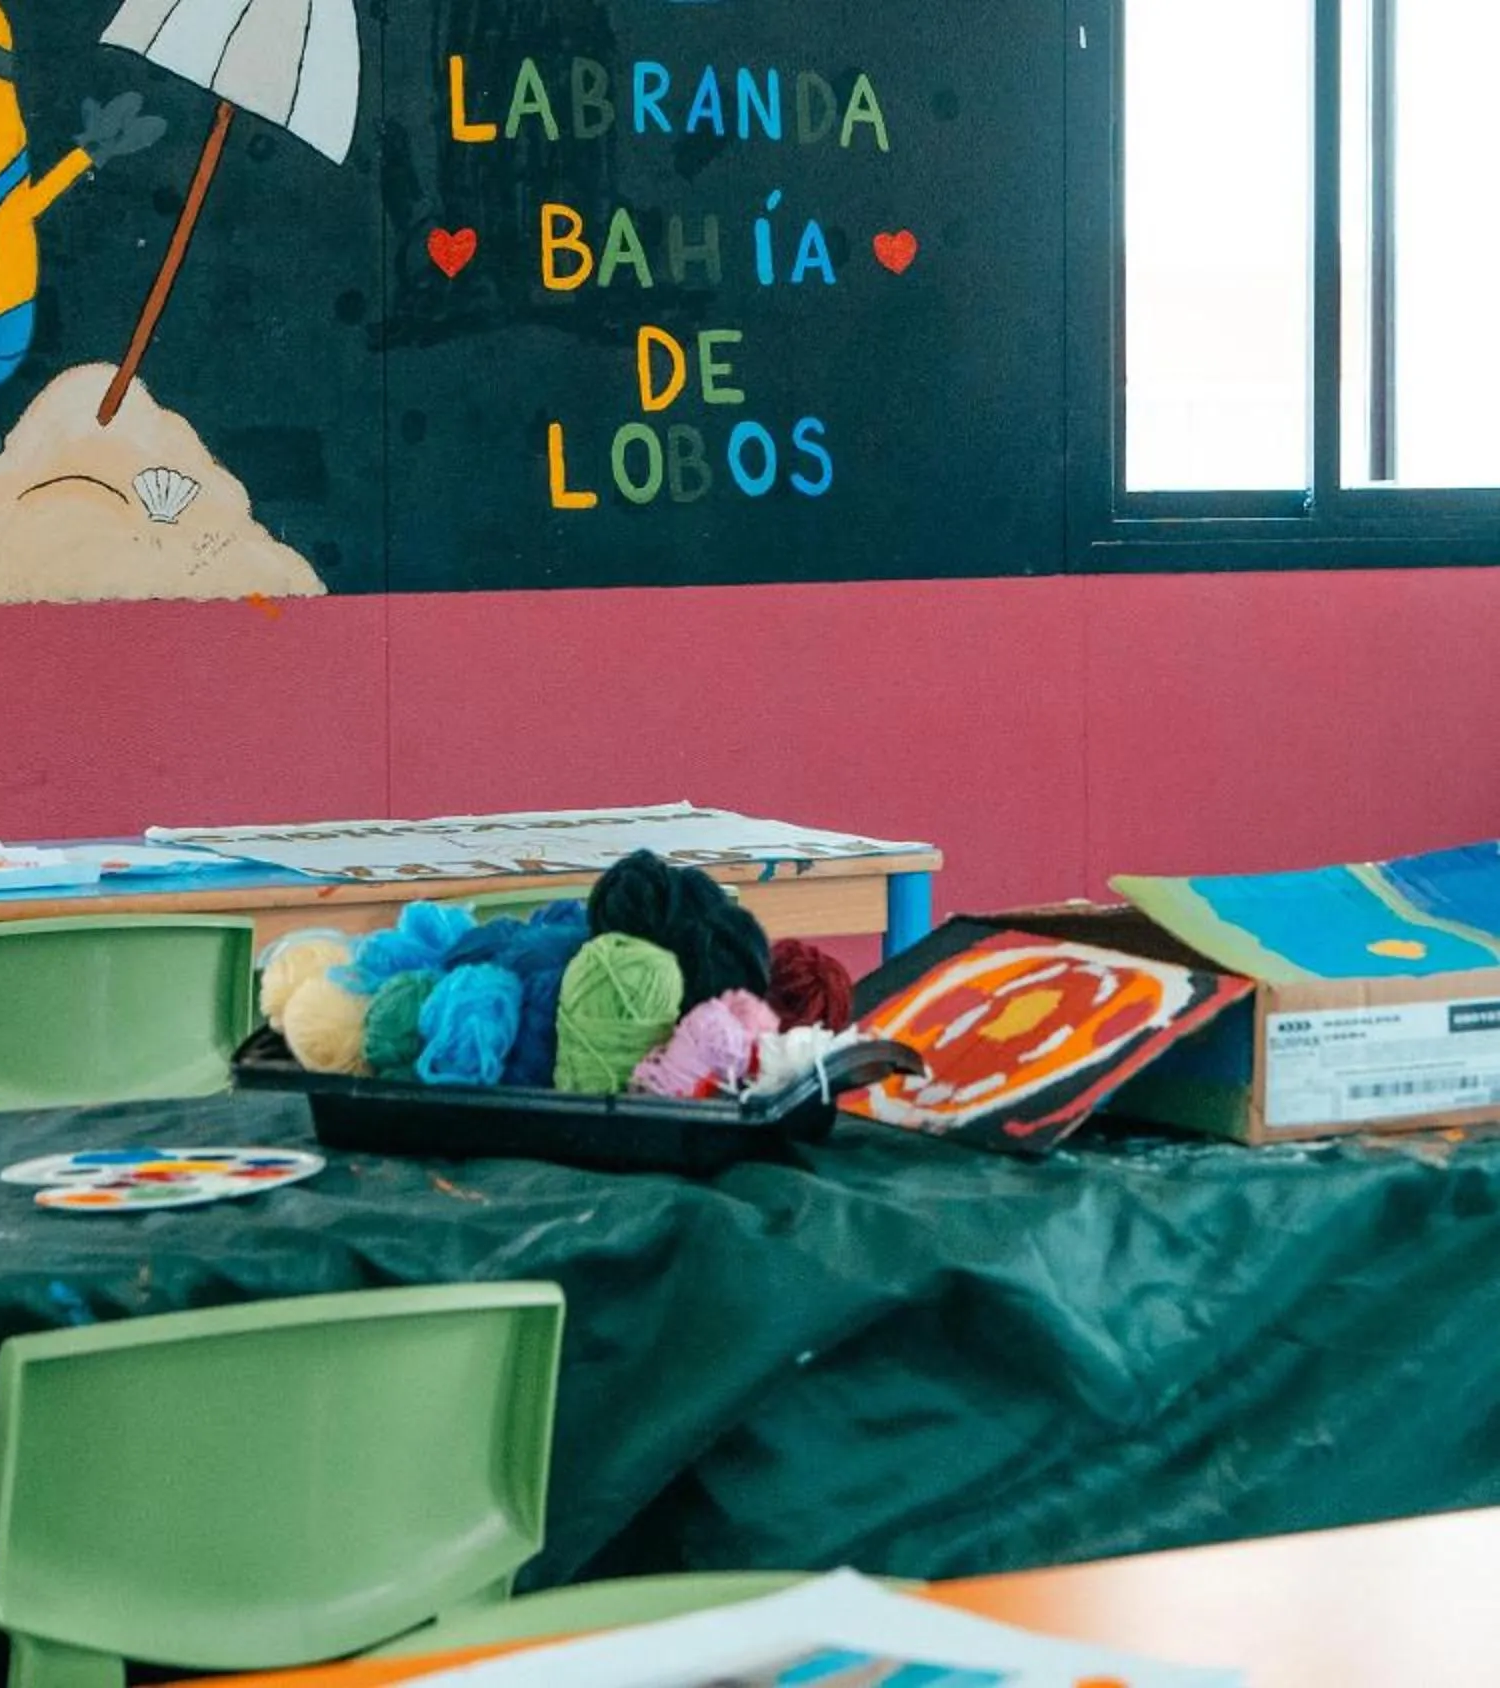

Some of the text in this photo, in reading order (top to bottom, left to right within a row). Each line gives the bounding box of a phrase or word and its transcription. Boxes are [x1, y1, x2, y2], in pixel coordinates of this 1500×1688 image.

[448, 55, 890, 153] LABRANDA
[541, 189, 836, 292] BAHÍA
[636, 325, 746, 413] DE
[546, 417, 833, 510] LOBOS
